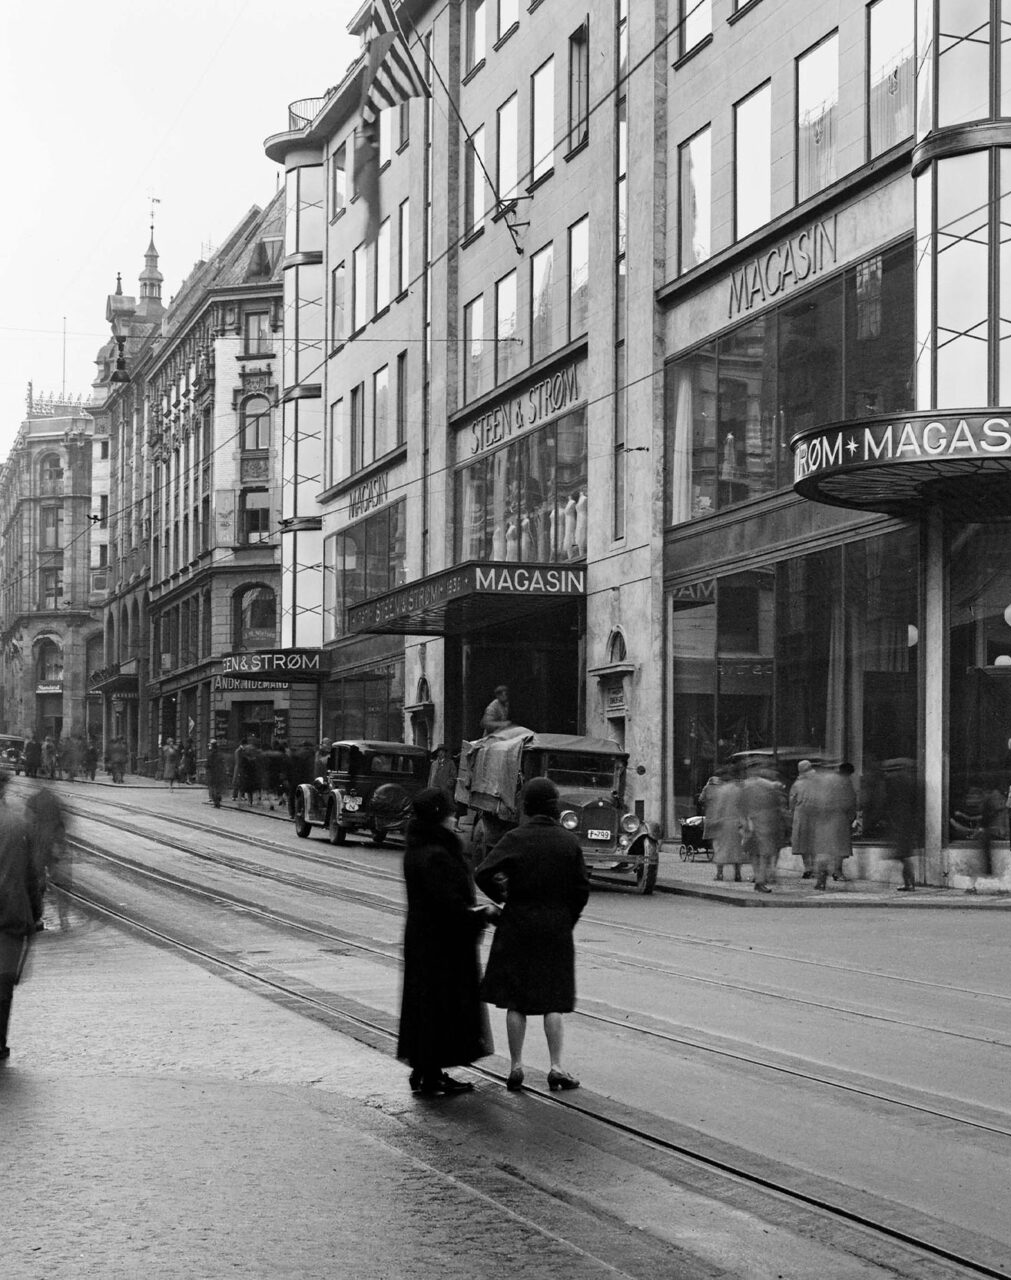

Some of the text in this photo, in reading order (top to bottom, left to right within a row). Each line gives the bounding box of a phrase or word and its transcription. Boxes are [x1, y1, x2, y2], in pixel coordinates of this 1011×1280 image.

[728, 214, 838, 319] MAGASIN
[470, 363, 579, 455] STEEN & STRØM
[348, 471, 389, 521] MAGASIN
[475, 567, 584, 593] MAGASIN
[240, 656, 249, 671] &
[251, 654, 320, 671] STRØM
